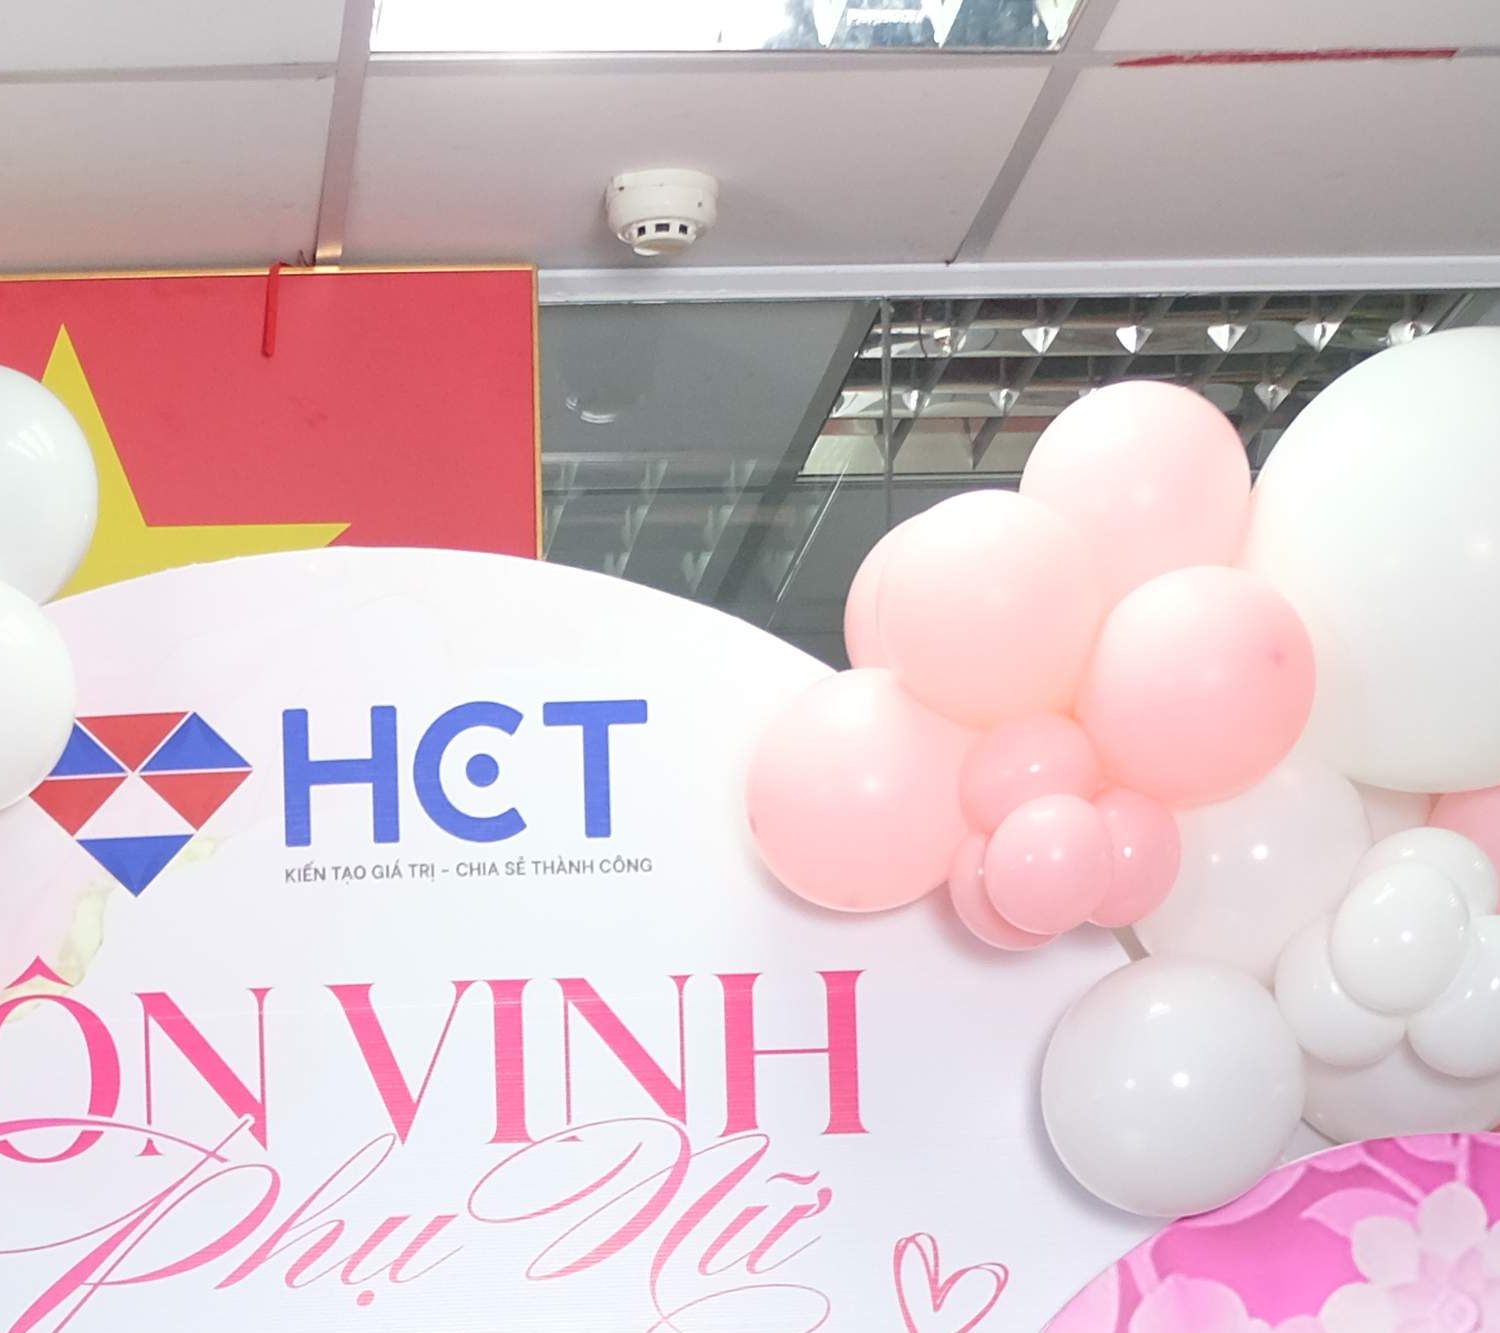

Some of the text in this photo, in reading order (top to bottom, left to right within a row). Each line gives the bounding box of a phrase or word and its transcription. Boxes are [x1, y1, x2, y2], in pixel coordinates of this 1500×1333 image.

[282, 699, 648, 847] HCT
[285, 860, 327, 883] KIẾN
[332, 865, 366, 885] TẠO
[371, 859, 403, 880] GIÁ
[408, 863, 435, 882] TRỊ
[455, 861, 500, 877] CHIA
[504, 856, 527, 876] SẺ
[531, 855, 595, 876] THÀNH
[599, 854, 653, 874] CÔNG
[323, 968, 871, 1147] VINH
